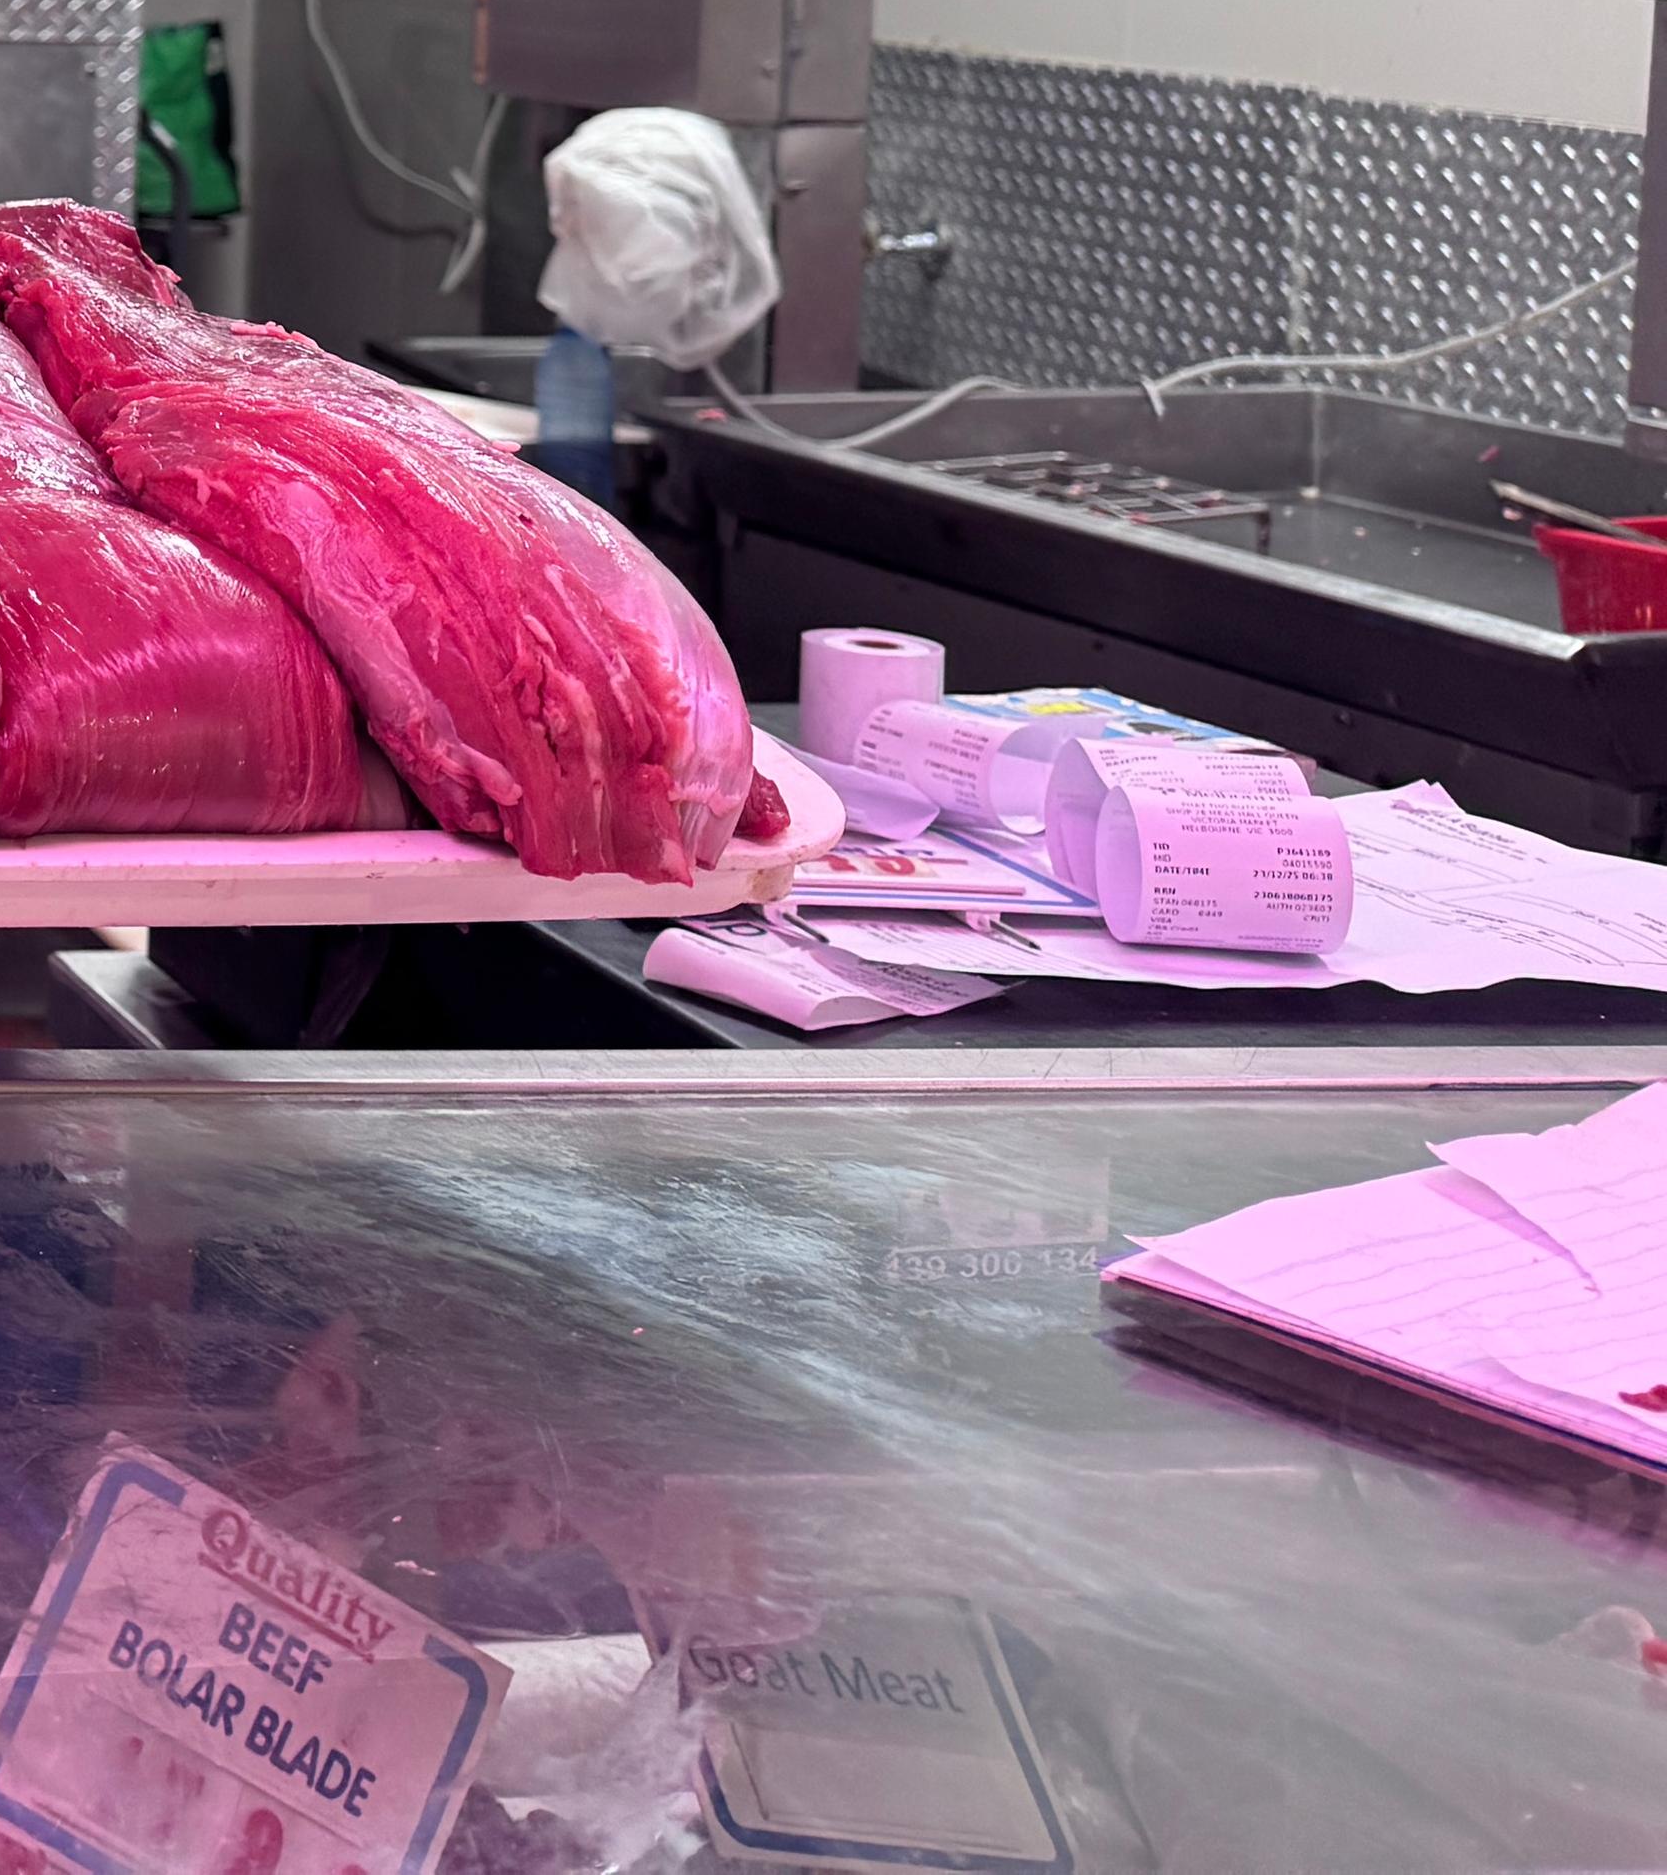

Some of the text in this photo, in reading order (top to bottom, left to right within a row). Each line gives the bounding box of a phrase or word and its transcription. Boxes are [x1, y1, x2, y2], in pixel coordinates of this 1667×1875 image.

[1181, 824, 1241, 835] MELBOURNE
[1246, 826, 1263, 835] VIC
[200, 1506, 396, 1663] Quality
[219, 1601, 333, 1696] BEEF
[687, 1633, 966, 1714] Goat Meat
[108, 1620, 378, 1818] BOLAR BLADE
